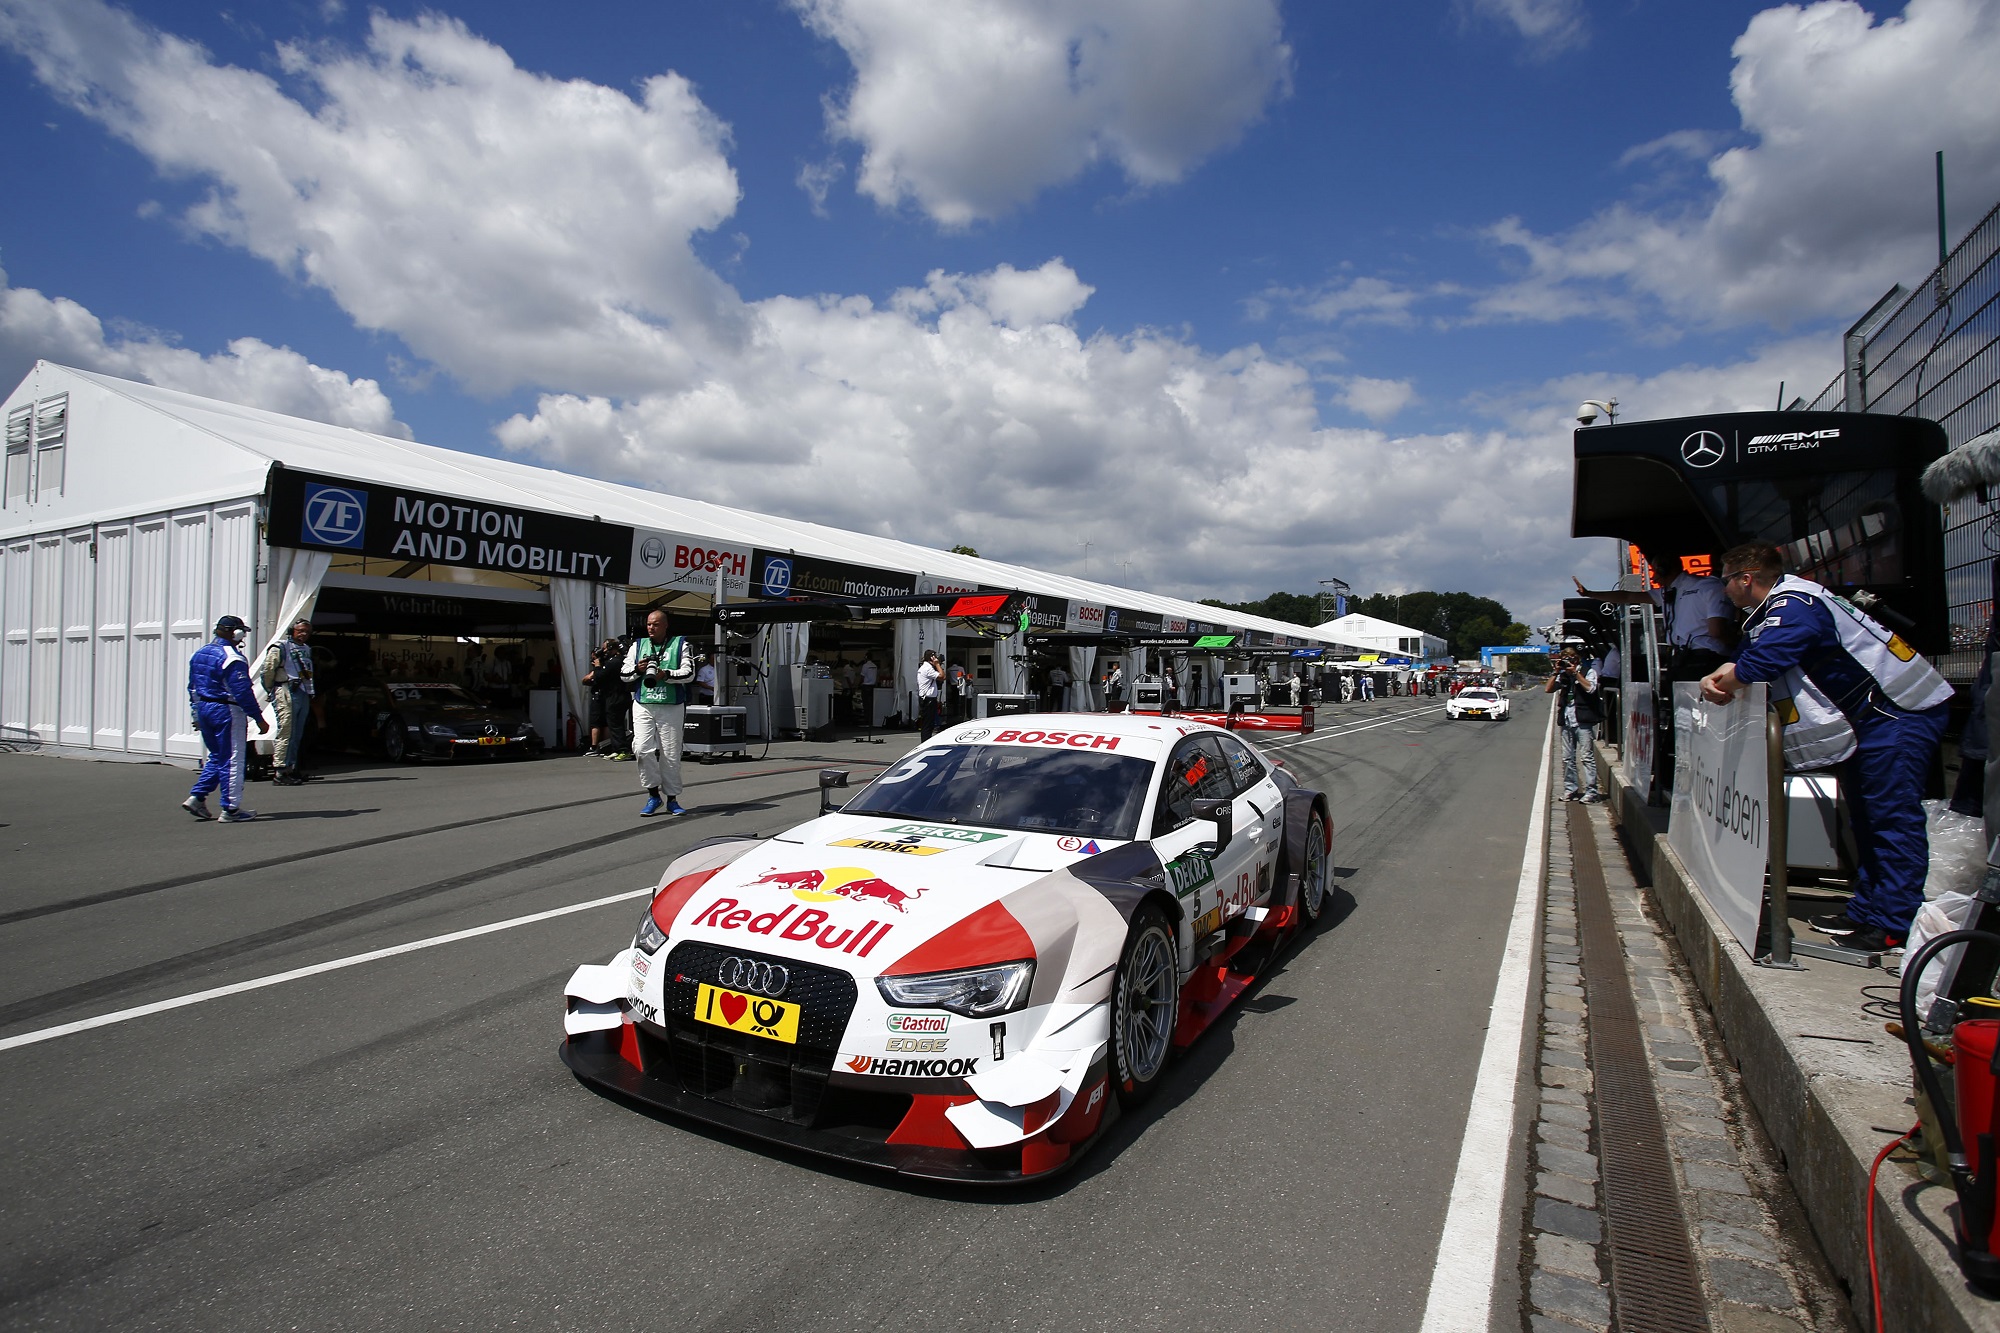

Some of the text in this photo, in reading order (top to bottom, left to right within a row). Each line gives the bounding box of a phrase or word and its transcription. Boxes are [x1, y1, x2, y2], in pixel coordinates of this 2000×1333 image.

[1779, 428, 1840, 442] AMG
[1747, 440, 1820, 454] DTM TEAM
[313, 497, 361, 533] ZF
[393, 496, 525, 539] MOTION
[391, 529, 612, 577] AND MOBILITY
[674, 544, 747, 577] BOSCH
[766, 566, 790, 588] ZF
[383, 596, 463, 616] Wehrlein
[588, 606, 599, 620] 24
[1079, 607, 1103, 622] BOSCH
[394, 688, 423, 701] 94
[993, 730, 1121, 750] BOSCH
[878, 750, 952, 785] 5
[1216, 806, 1232, 816] ORIS
[1715, 767, 1761, 849] Leben
[895, 824, 984, 842] DEKRA
[896, 835, 926, 844] 5
[853, 840, 919, 854] ADAC
[1174, 859, 1209, 893] DEKRA
[1193, 889, 1202, 919] 5
[706, 988, 715, 1020] I
[902, 1016, 946, 1031] Castrol
[885, 1037, 950, 1053] EDGE
[1085, 1080, 1106, 1115] ABT
